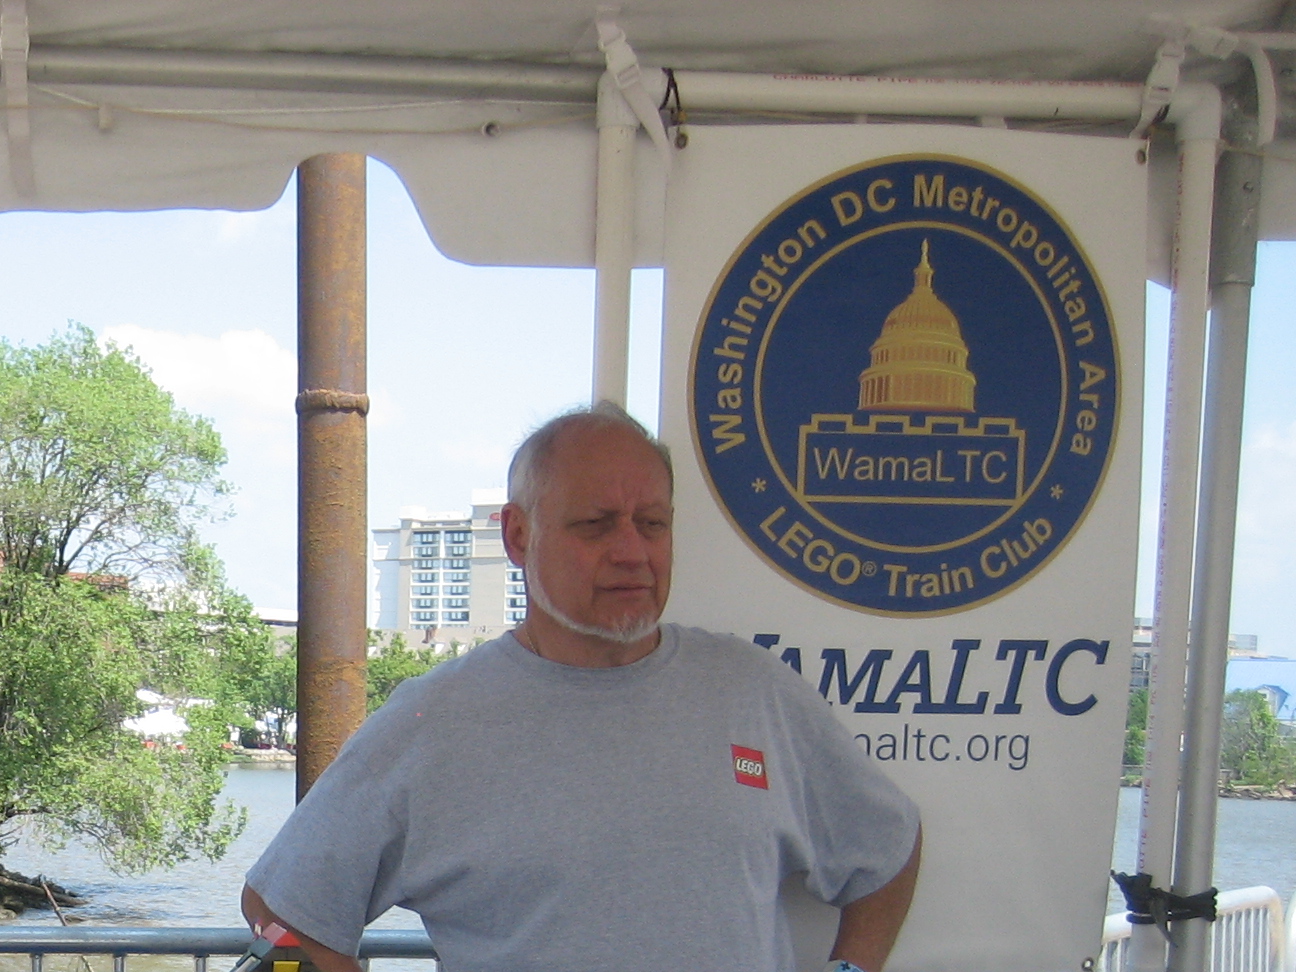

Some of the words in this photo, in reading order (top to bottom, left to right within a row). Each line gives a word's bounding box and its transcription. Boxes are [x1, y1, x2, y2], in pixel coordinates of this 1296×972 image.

[708, 218, 828, 453] Washington
[831, 178, 897, 227] DC
[912, 174, 1097, 348] Metropolitan
[1069, 360, 1107, 457] Area
[812, 447, 1008, 484] WamaLTC
[882, 562, 974, 598] Train
[979, 514, 1053, 579] Club
[753, 633, 1110, 716] MALTC
[735, 757, 763, 776] LEGO
[853, 722, 1031, 771] altc.org
